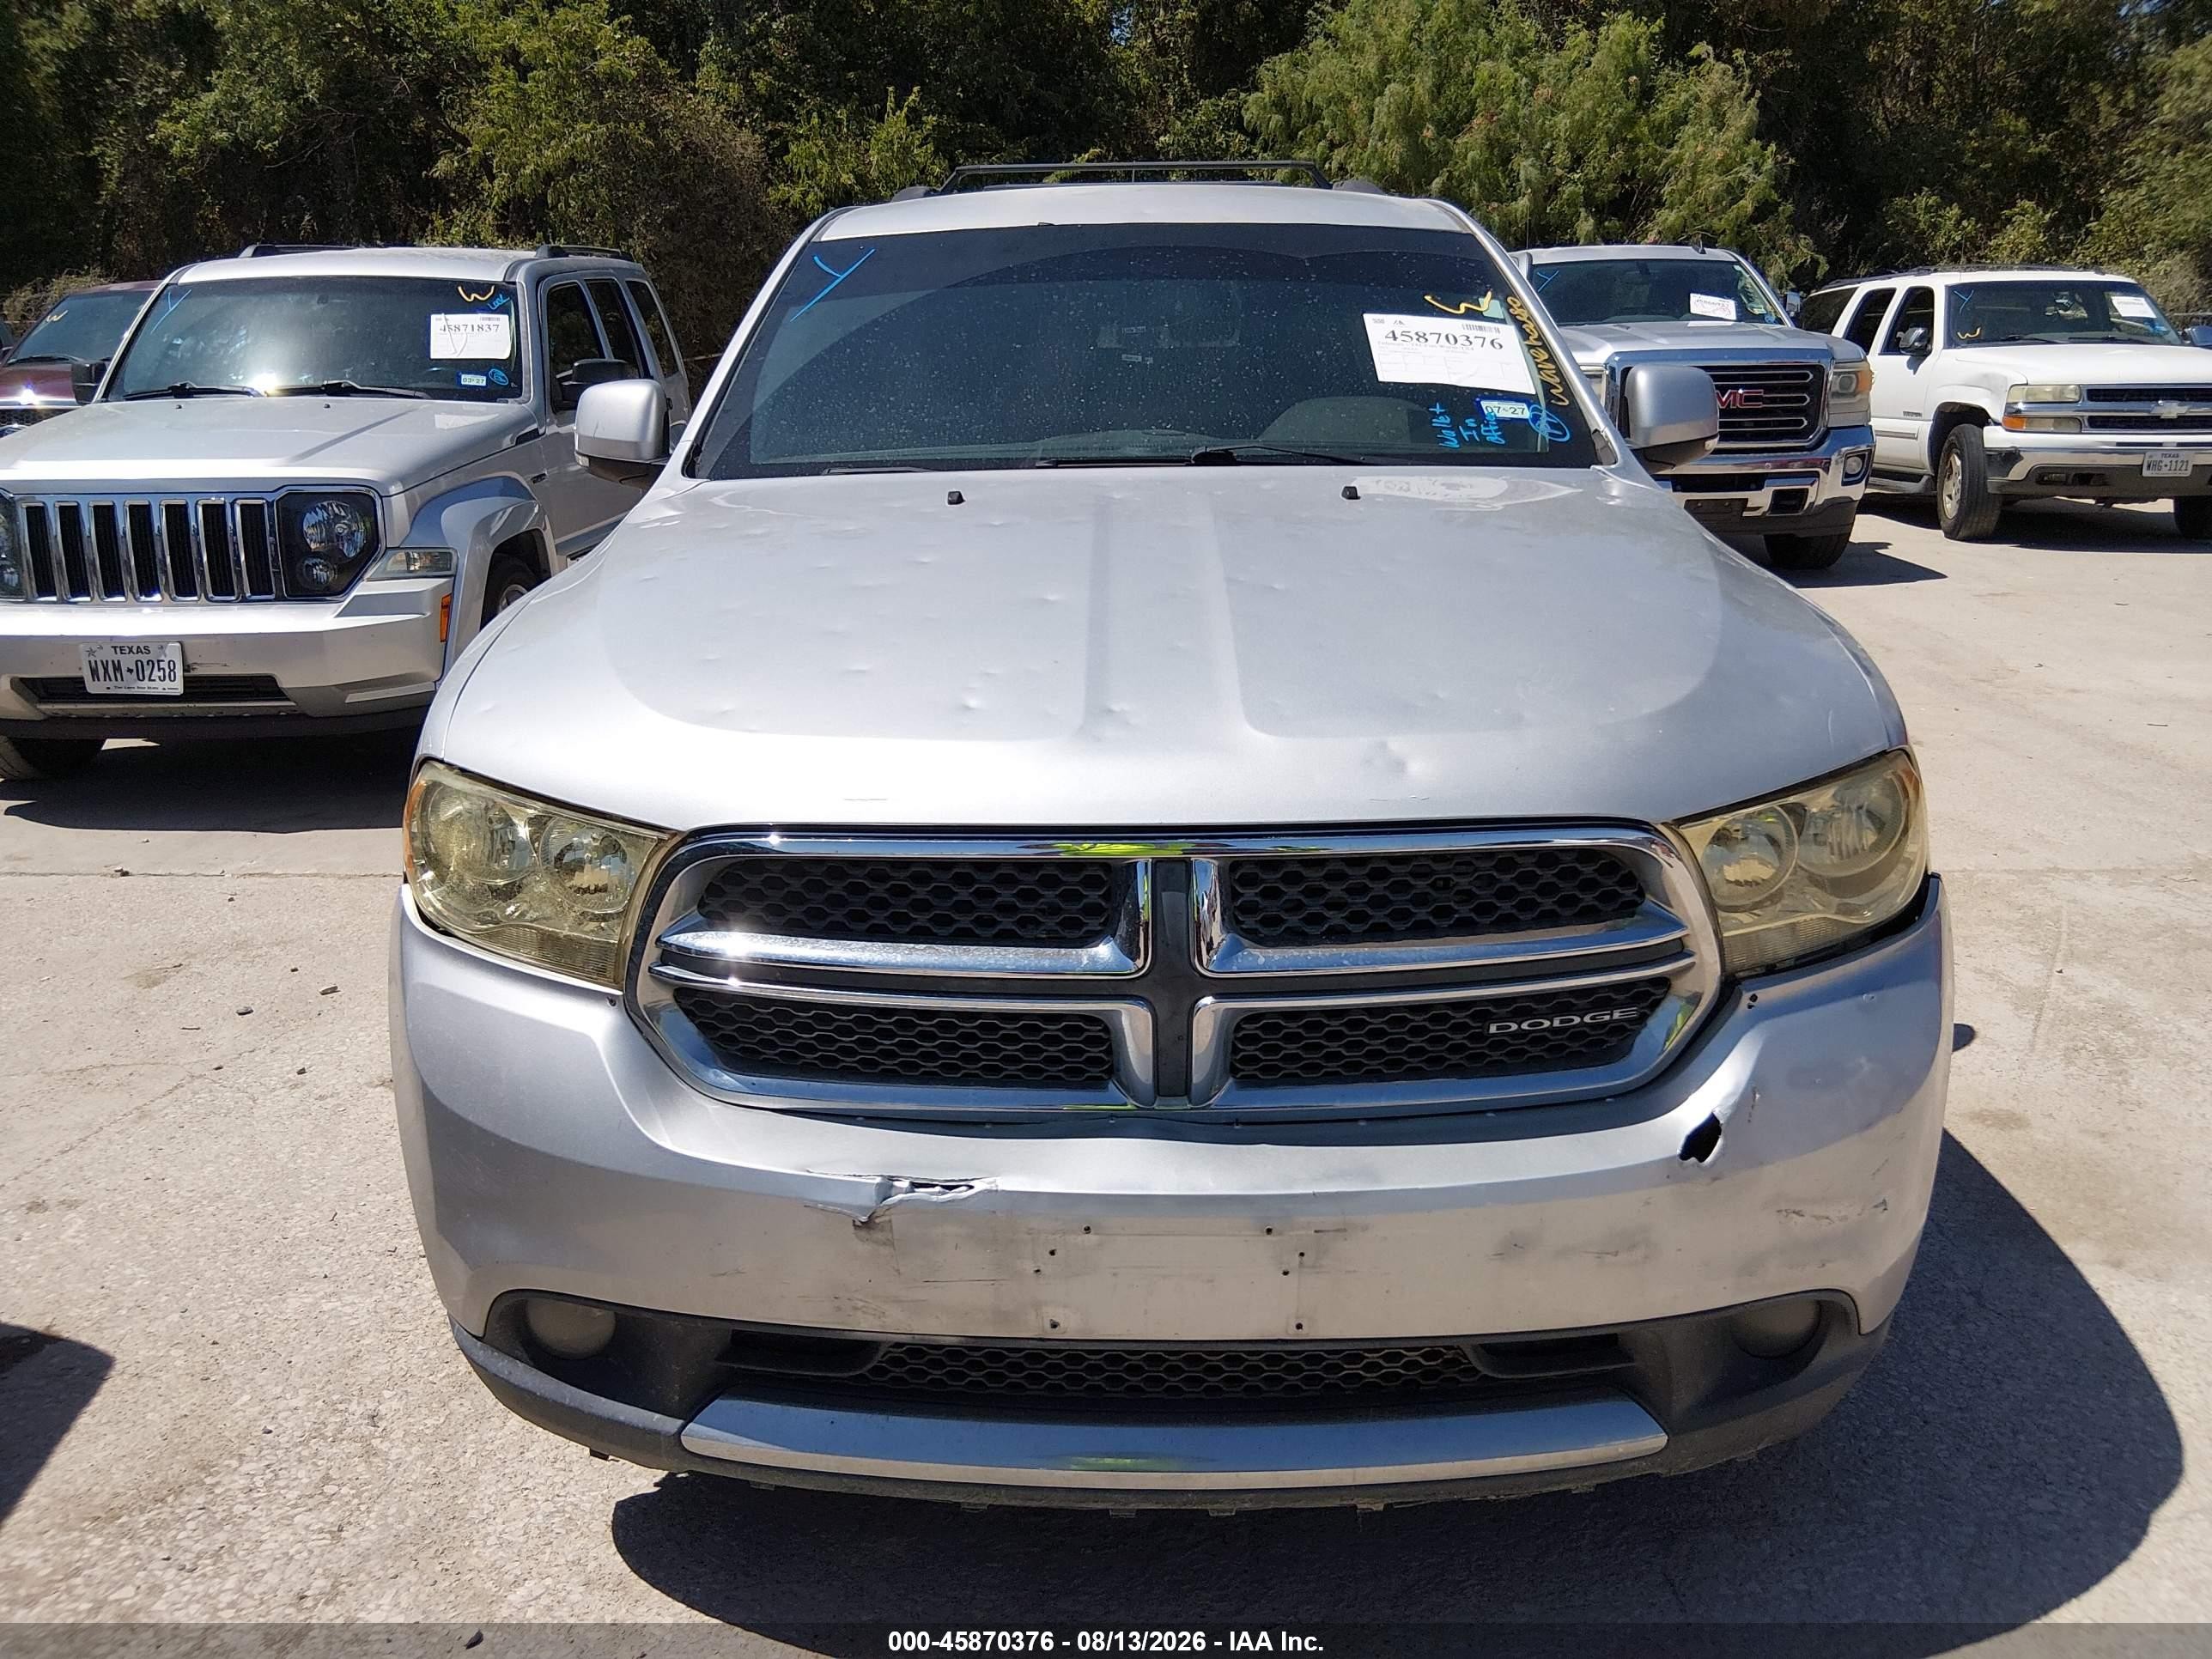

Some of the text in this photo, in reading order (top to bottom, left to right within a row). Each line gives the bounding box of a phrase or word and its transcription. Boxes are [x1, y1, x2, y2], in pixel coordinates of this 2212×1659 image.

[439, 324, 500, 333] 45871837
[1385, 329, 1504, 350] 45870376
[1716, 389, 1765, 409] MC
[111, 645, 151, 655] TEXAS
[1488, 1006, 1638, 1034] DODGE
